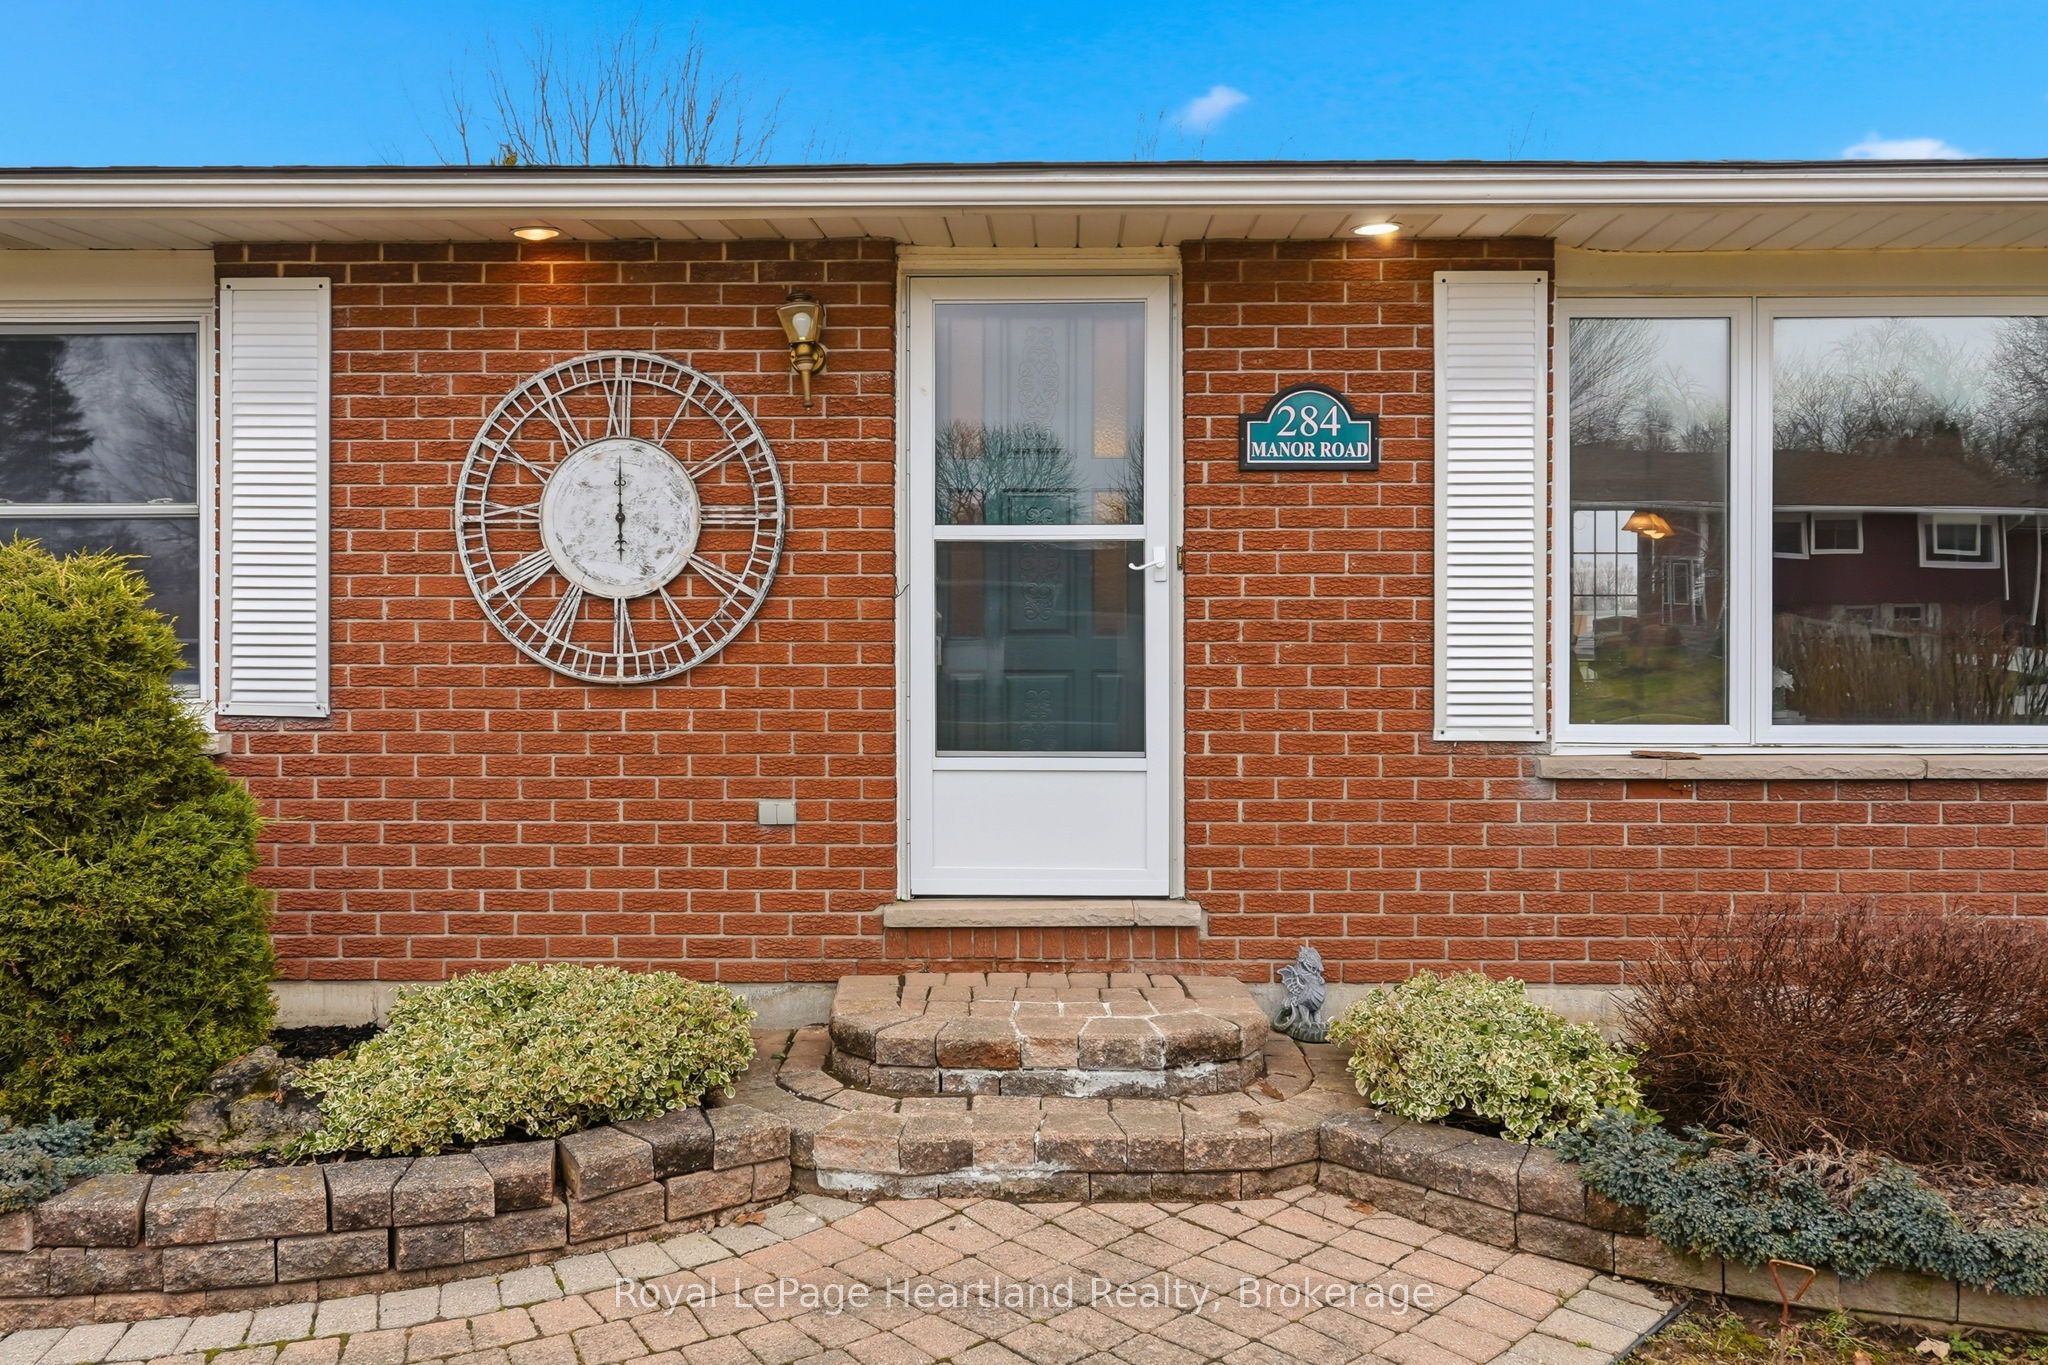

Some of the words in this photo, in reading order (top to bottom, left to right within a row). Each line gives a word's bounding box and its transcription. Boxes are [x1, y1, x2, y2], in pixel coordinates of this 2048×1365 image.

[1276, 405, 1341, 437] 284
[1251, 441, 1315, 457] MANOR
[1319, 441, 1368, 457] ROAD
